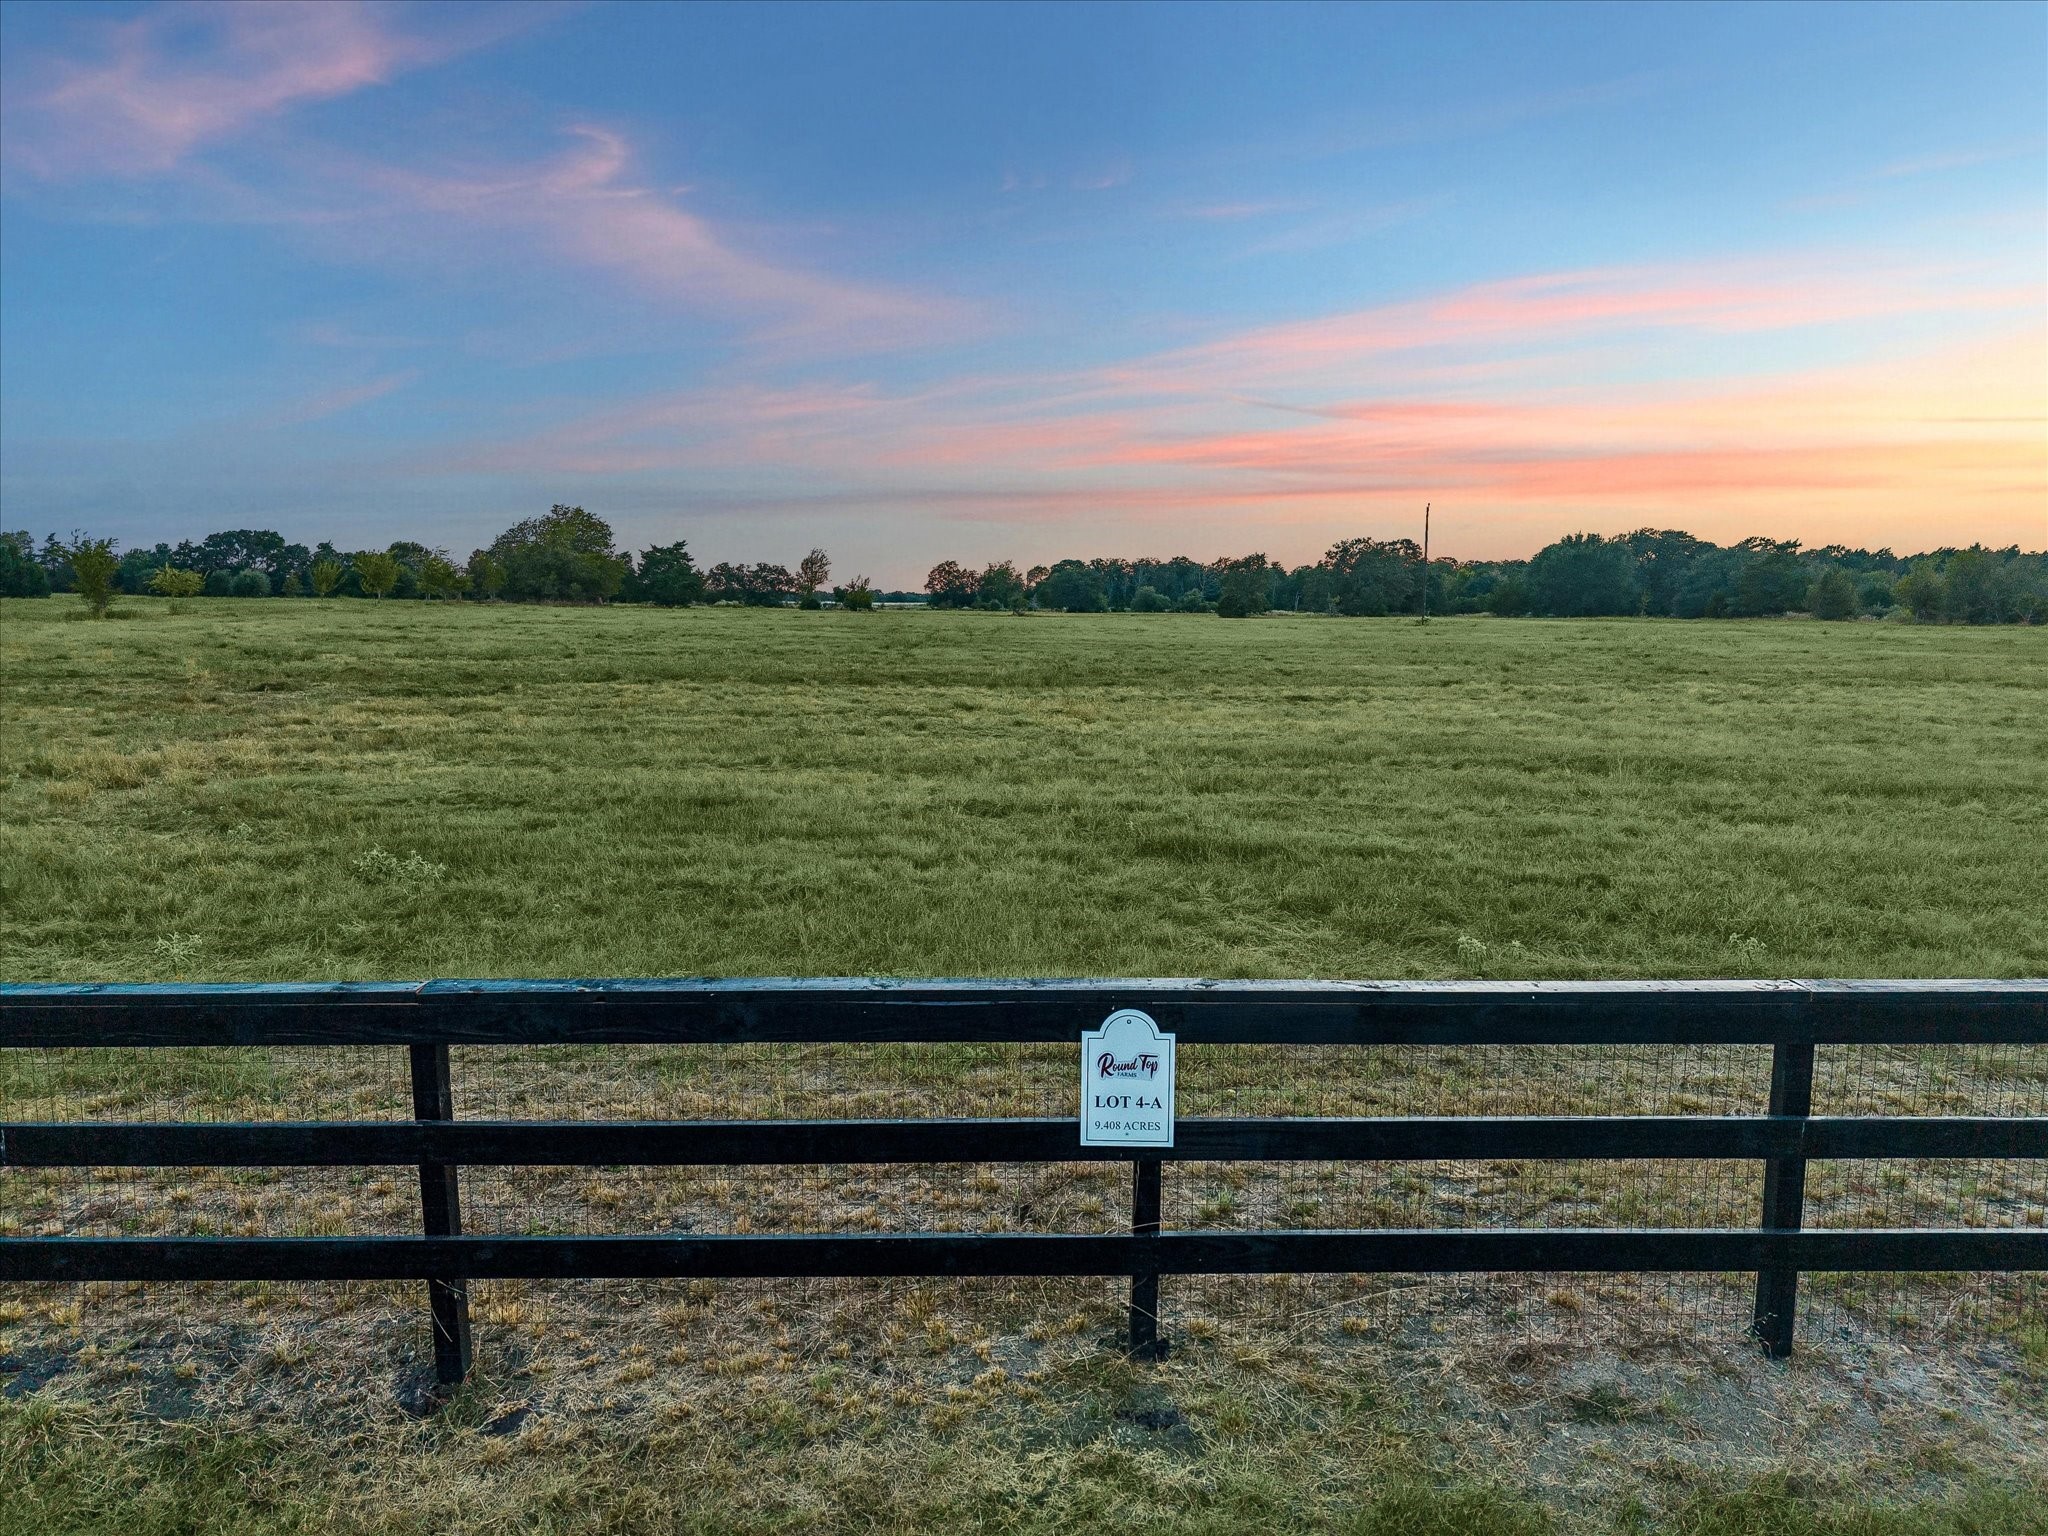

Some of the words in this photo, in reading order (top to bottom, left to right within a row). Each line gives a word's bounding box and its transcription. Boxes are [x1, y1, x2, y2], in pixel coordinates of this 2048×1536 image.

[1097, 1052, 1138, 1078] Round
[1138, 1054, 1158, 1079] Top
[1095, 1095, 1131, 1108] LOT
[1135, 1096, 1162, 1109] 4-A
[1094, 1120, 1121, 1130] 9.408
[1123, 1121, 1161, 1131] ACRES
